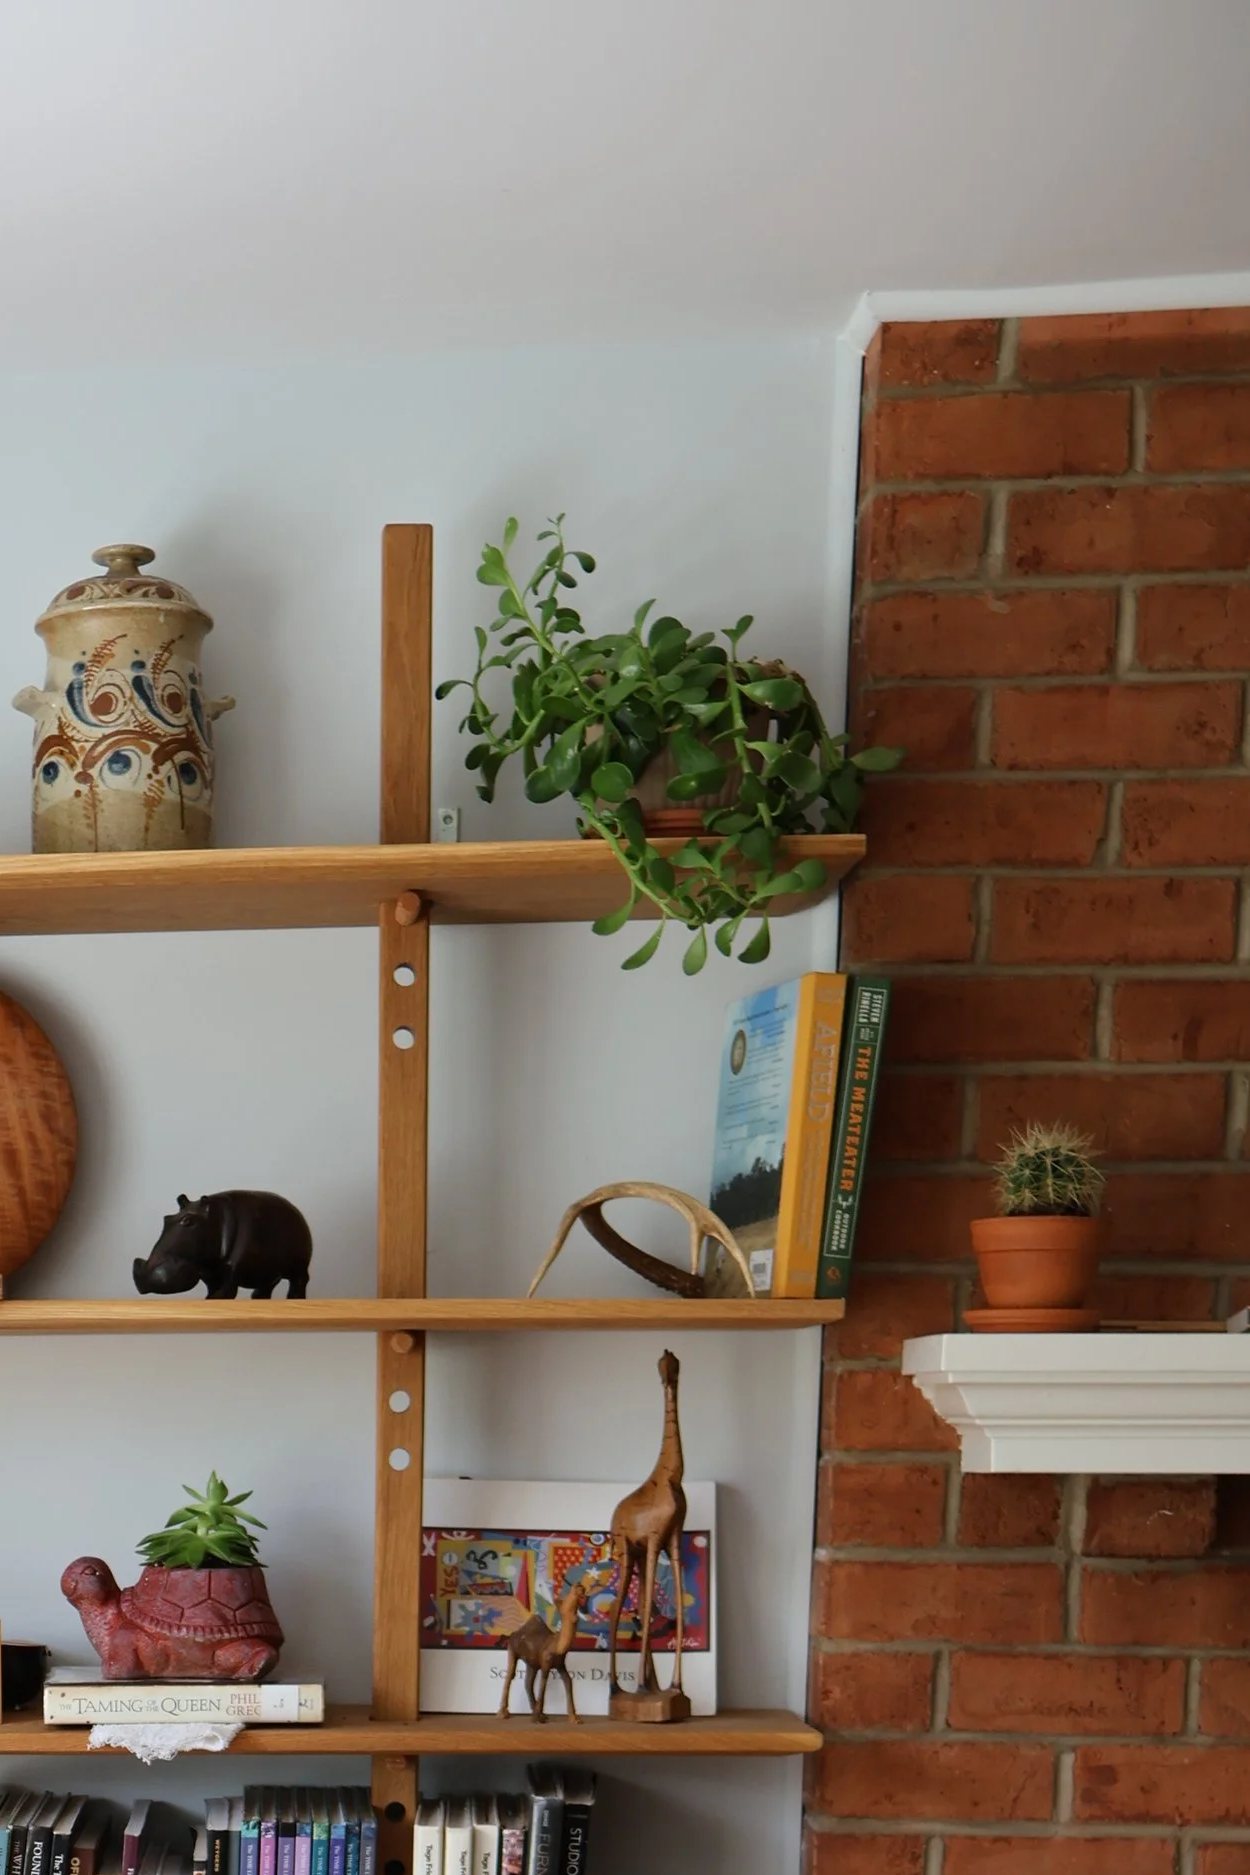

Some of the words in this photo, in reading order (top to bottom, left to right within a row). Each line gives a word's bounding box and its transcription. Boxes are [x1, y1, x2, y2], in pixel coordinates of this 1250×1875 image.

[854, 1047, 871, 1080] THE
[839, 1087, 866, 1192] MEATEATER
[440, 1565, 459, 1597] YES
[72, 1697, 143, 1715] TAMING
[160, 1698, 222, 1718] QUEEN
[52, 1853, 64, 1870] The
[424, 1844, 433, 1861] Tage
